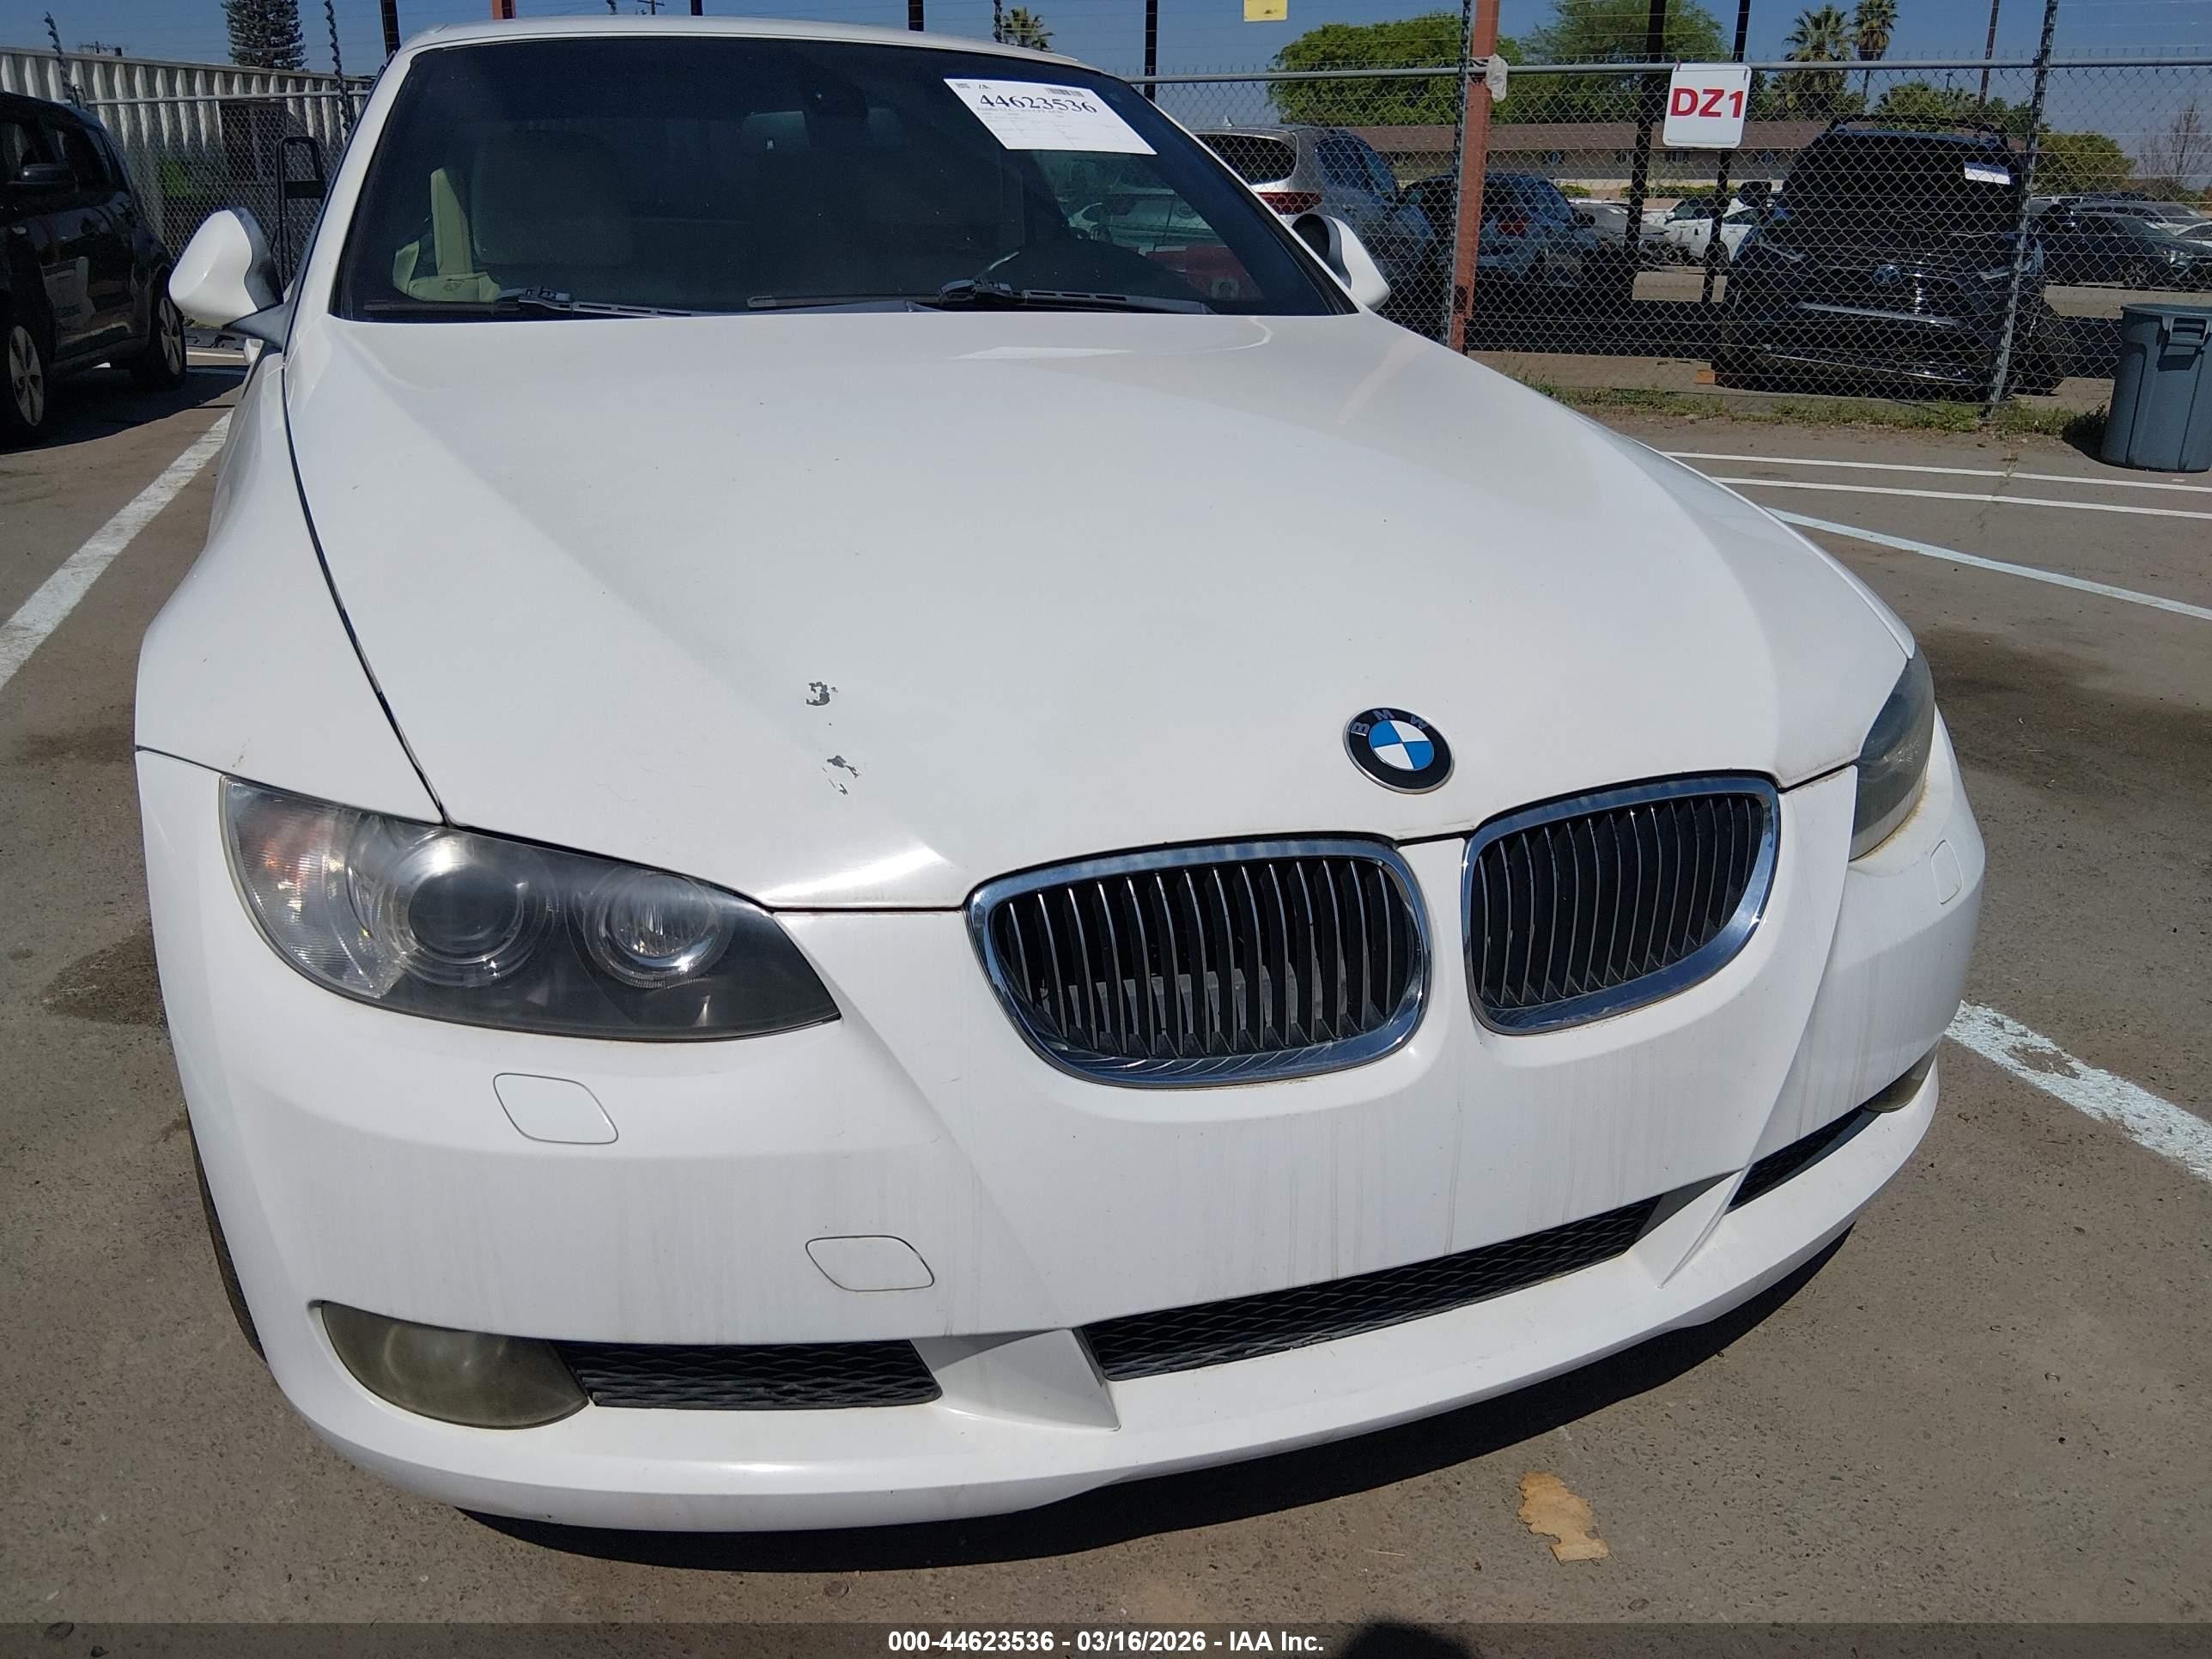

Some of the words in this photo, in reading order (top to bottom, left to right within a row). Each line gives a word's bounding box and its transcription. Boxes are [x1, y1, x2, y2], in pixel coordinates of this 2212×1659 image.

[980, 94, 1097, 114] 44623536
[1670, 88, 1744, 118] DZ1
[1351, 709, 1429, 737] BMW
